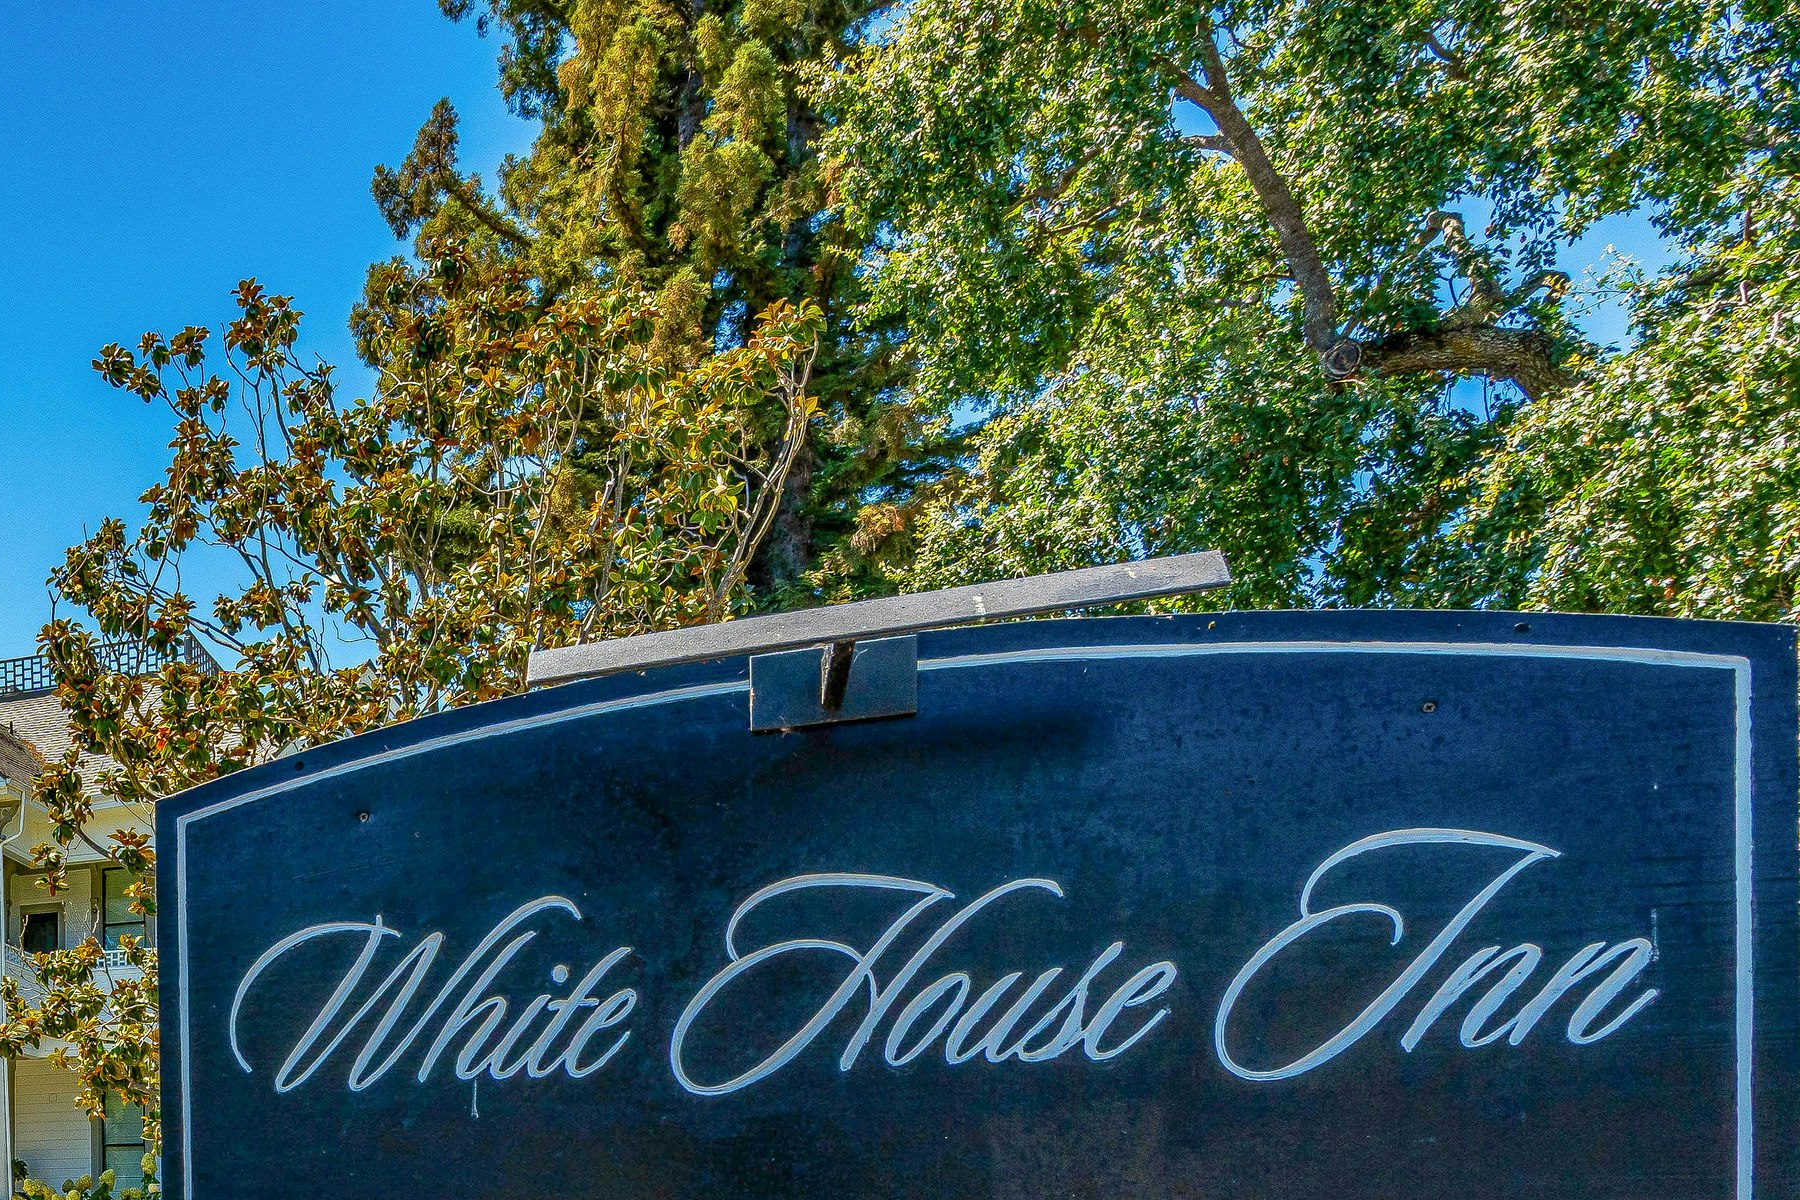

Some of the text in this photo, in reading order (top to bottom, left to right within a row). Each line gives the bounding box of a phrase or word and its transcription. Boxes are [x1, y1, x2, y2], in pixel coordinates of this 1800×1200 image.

[229, 826, 1660, 1097] White House Inn
